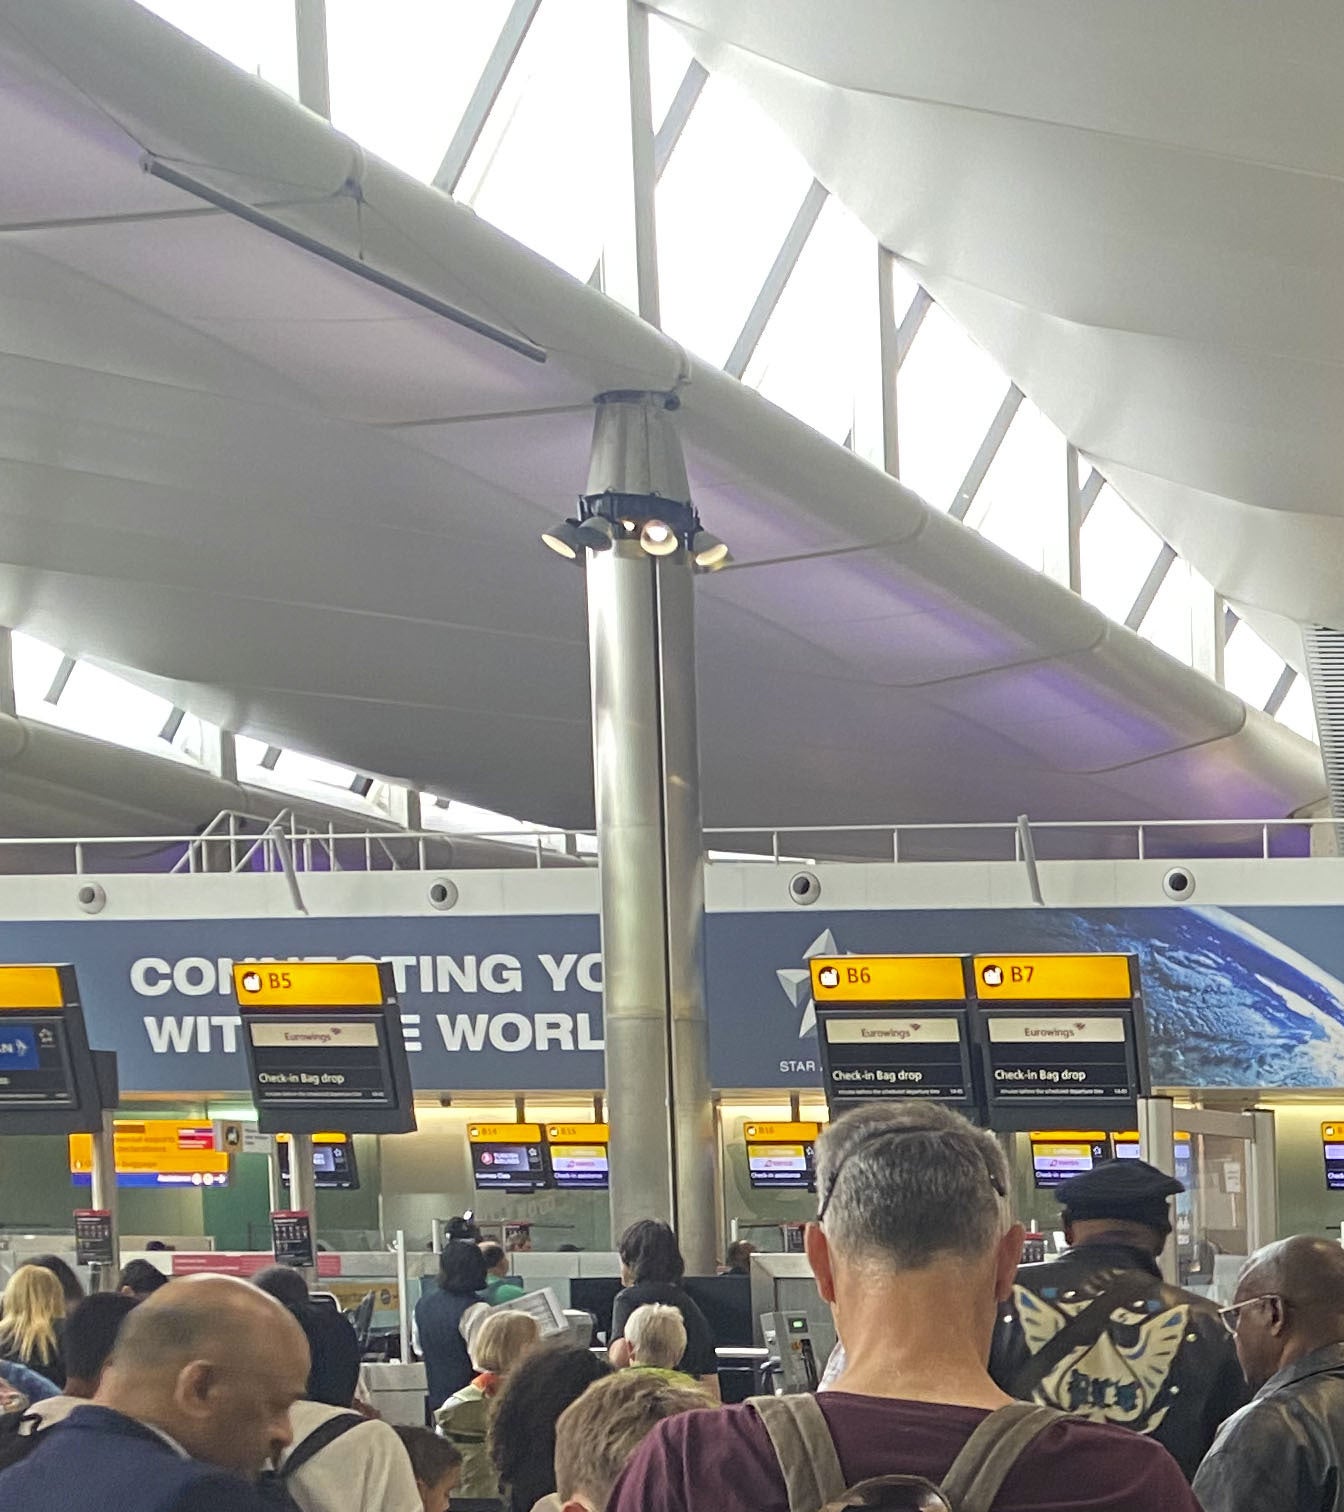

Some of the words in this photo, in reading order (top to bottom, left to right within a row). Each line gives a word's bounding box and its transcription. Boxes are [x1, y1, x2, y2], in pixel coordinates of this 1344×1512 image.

[268, 972, 292, 989] B5
[847, 967, 871, 983] B6
[1011, 966, 1034, 983] B7
[284, 1032, 332, 1043] Eurowings
[861, 1028, 911, 1039] Eurowings
[1024, 1027, 1075, 1038] Eurowings
[779, 1061, 816, 1073] STAR
[258, 1073, 300, 1084] Check-in
[300, 1073, 320, 1086] Bag
[321, 1073, 345, 1085] drop
[832, 1070, 874, 1081] Check-in
[876, 1070, 896, 1083] Bag
[897, 1070, 923, 1083] drop
[994, 1069, 1037, 1081] Check-in
[1039, 1070, 1059, 1083] Bag
[1061, 1069, 1086, 1082] drop
